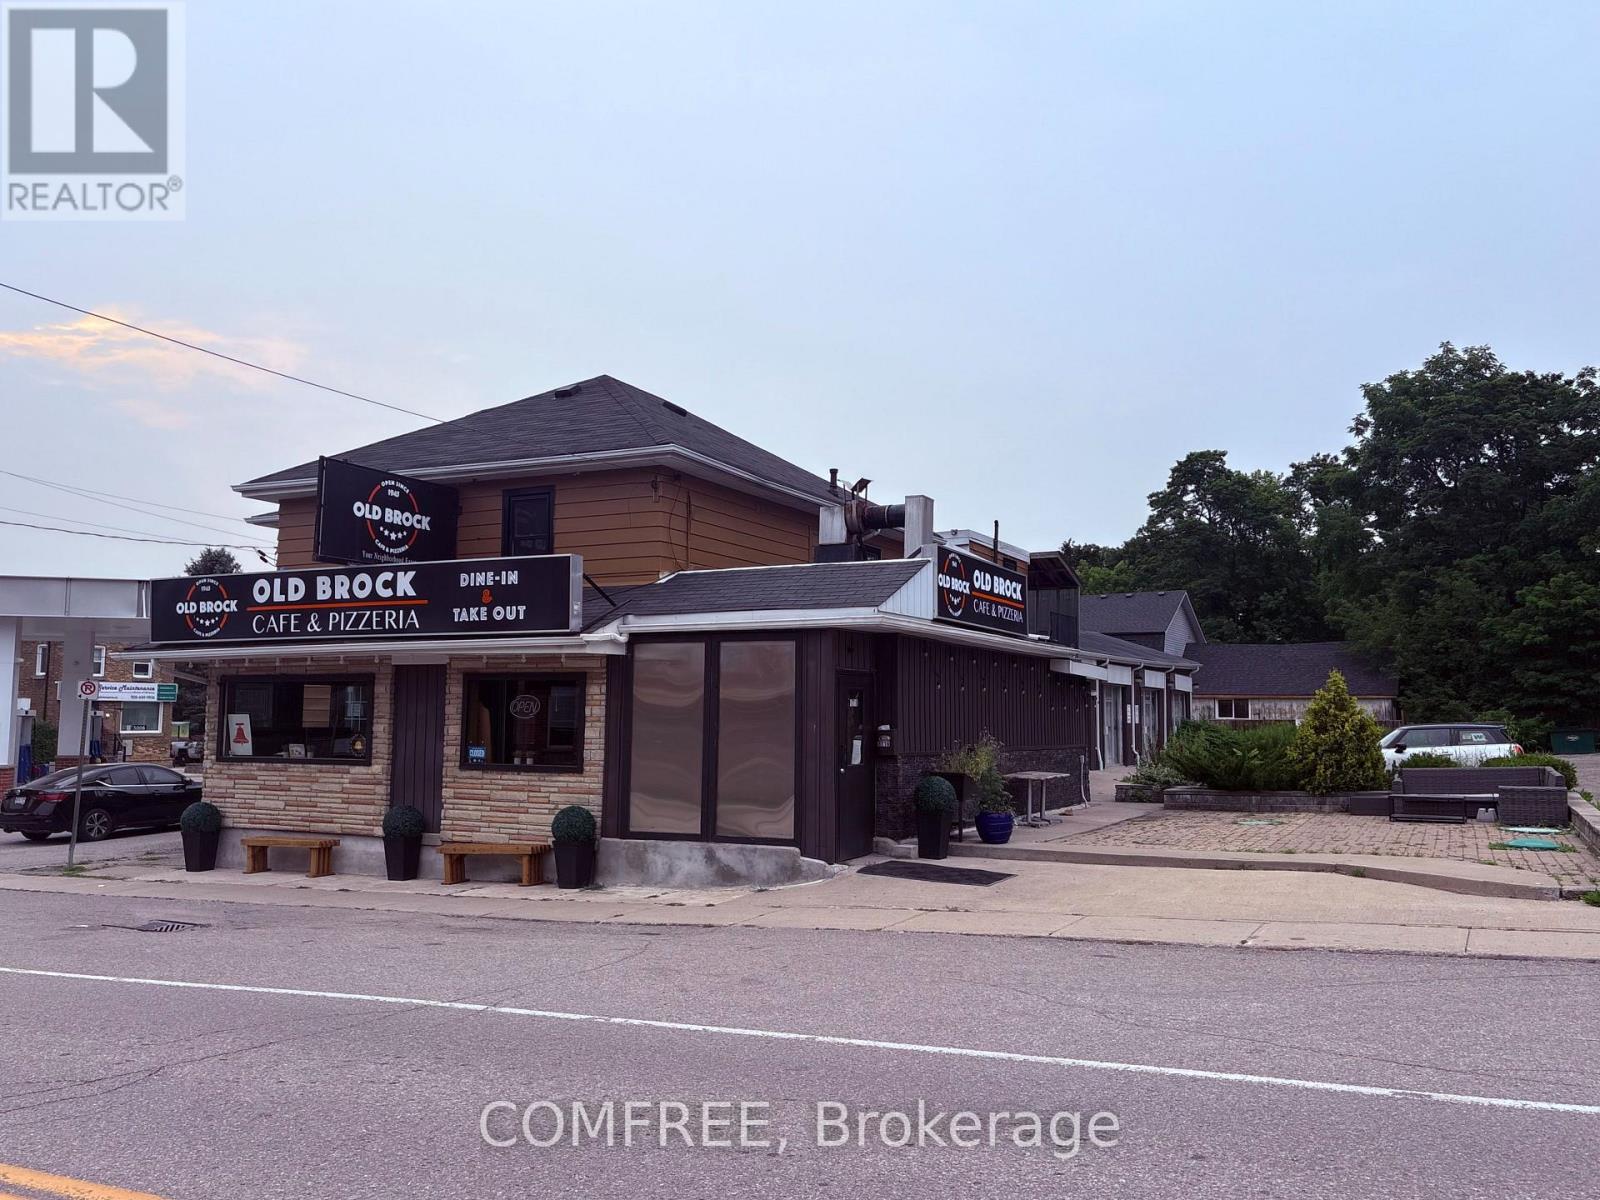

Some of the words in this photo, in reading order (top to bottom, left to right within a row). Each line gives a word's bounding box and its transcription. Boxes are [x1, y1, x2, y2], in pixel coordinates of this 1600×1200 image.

[352, 501, 382, 521] OLD
[384, 508, 431, 531] BROCK
[252, 577, 306, 604] OLD
[316, 571, 417, 601] BROCK
[460, 570, 519, 587] DINE-IN
[938, 573, 951, 588] OLD
[951, 578, 970, 595] BROCK
[973, 569, 991, 591] OLD
[993, 576, 1022, 601] BROCK
[176, 602, 198, 615] OLD
[199, 599, 239, 613] BROCK
[481, 588, 492, 605] &
[252, 613, 302, 634] CAFE
[307, 612, 323, 632] &
[328, 609, 420, 632] PIZZERIA
[453, 606, 488, 622] TAKE
[492, 605, 526, 620] OUT
[973, 599, 991, 616] CAFE
[991, 603, 997, 618] &
[997, 605, 1024, 623] PIZZERIA
[511, 700, 538, 713] OPEN
